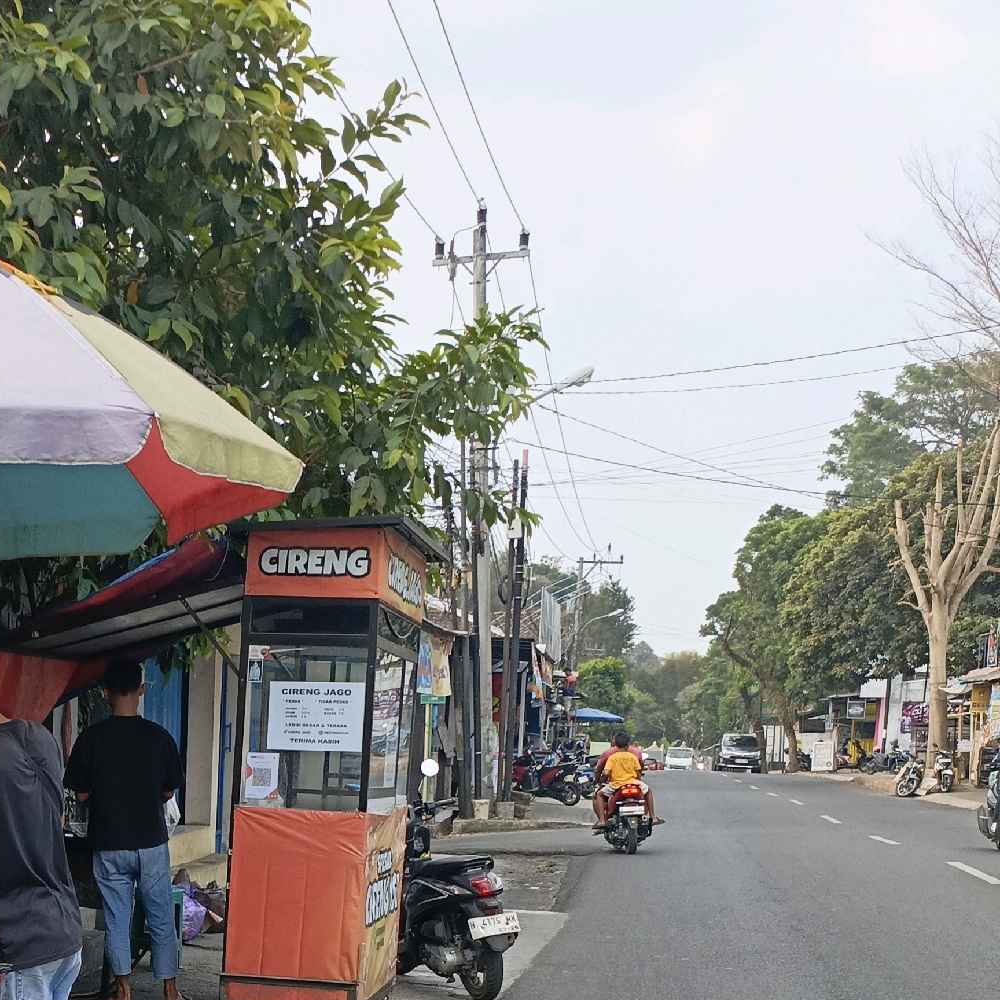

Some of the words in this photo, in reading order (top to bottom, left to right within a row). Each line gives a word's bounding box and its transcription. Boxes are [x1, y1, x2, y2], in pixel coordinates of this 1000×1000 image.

[260, 547, 371, 577] CIRENG
[281, 688, 321, 696] CIRENG
[323, 688, 352, 696] JAGO
[365, 875, 390, 928] CIRENG
